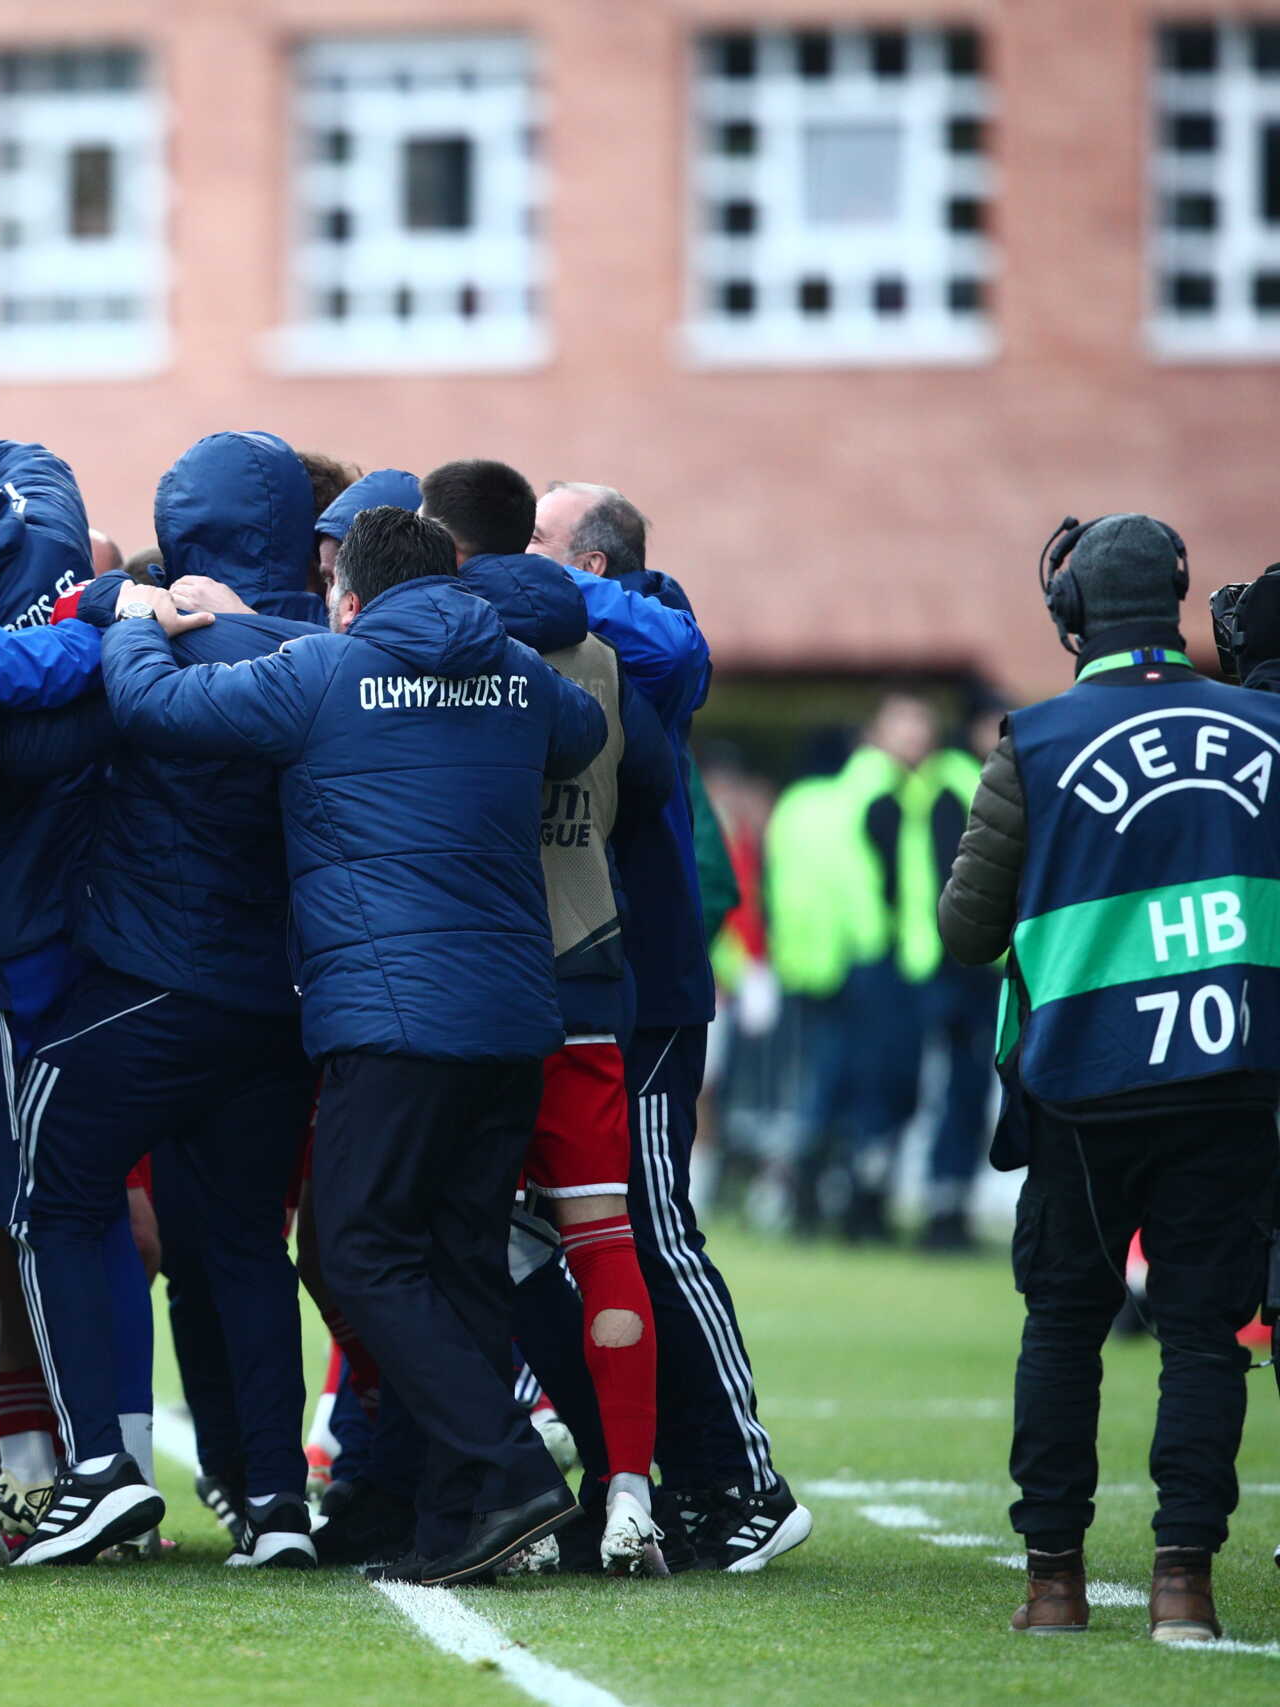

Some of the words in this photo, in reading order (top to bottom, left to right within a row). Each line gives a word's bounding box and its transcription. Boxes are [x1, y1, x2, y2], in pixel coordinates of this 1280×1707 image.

[508, 675, 529, 709] FC
[1073, 725, 1274, 815] UEFA
[1147, 889, 1248, 963] HB
